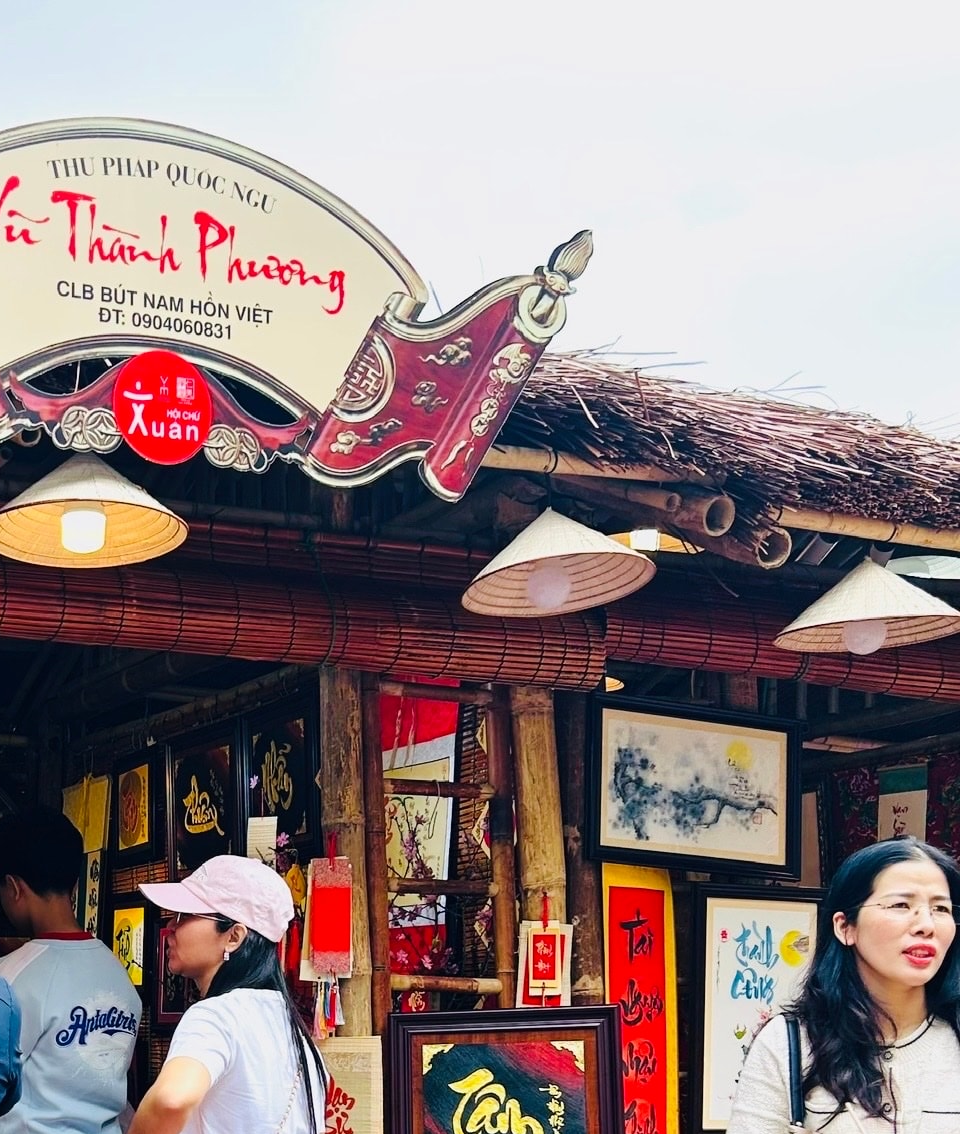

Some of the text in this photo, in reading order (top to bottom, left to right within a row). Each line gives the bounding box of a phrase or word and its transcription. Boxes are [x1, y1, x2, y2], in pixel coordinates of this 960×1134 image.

[51, 190, 182, 274] Thành
[193, 210, 346, 315] Phương
[56, 280, 273, 328] CLB BÚT NAM HỒN VIỆT
[98, 307, 231, 340] ĐT: 0904060831
[127, 402, 199, 442] Xuân
